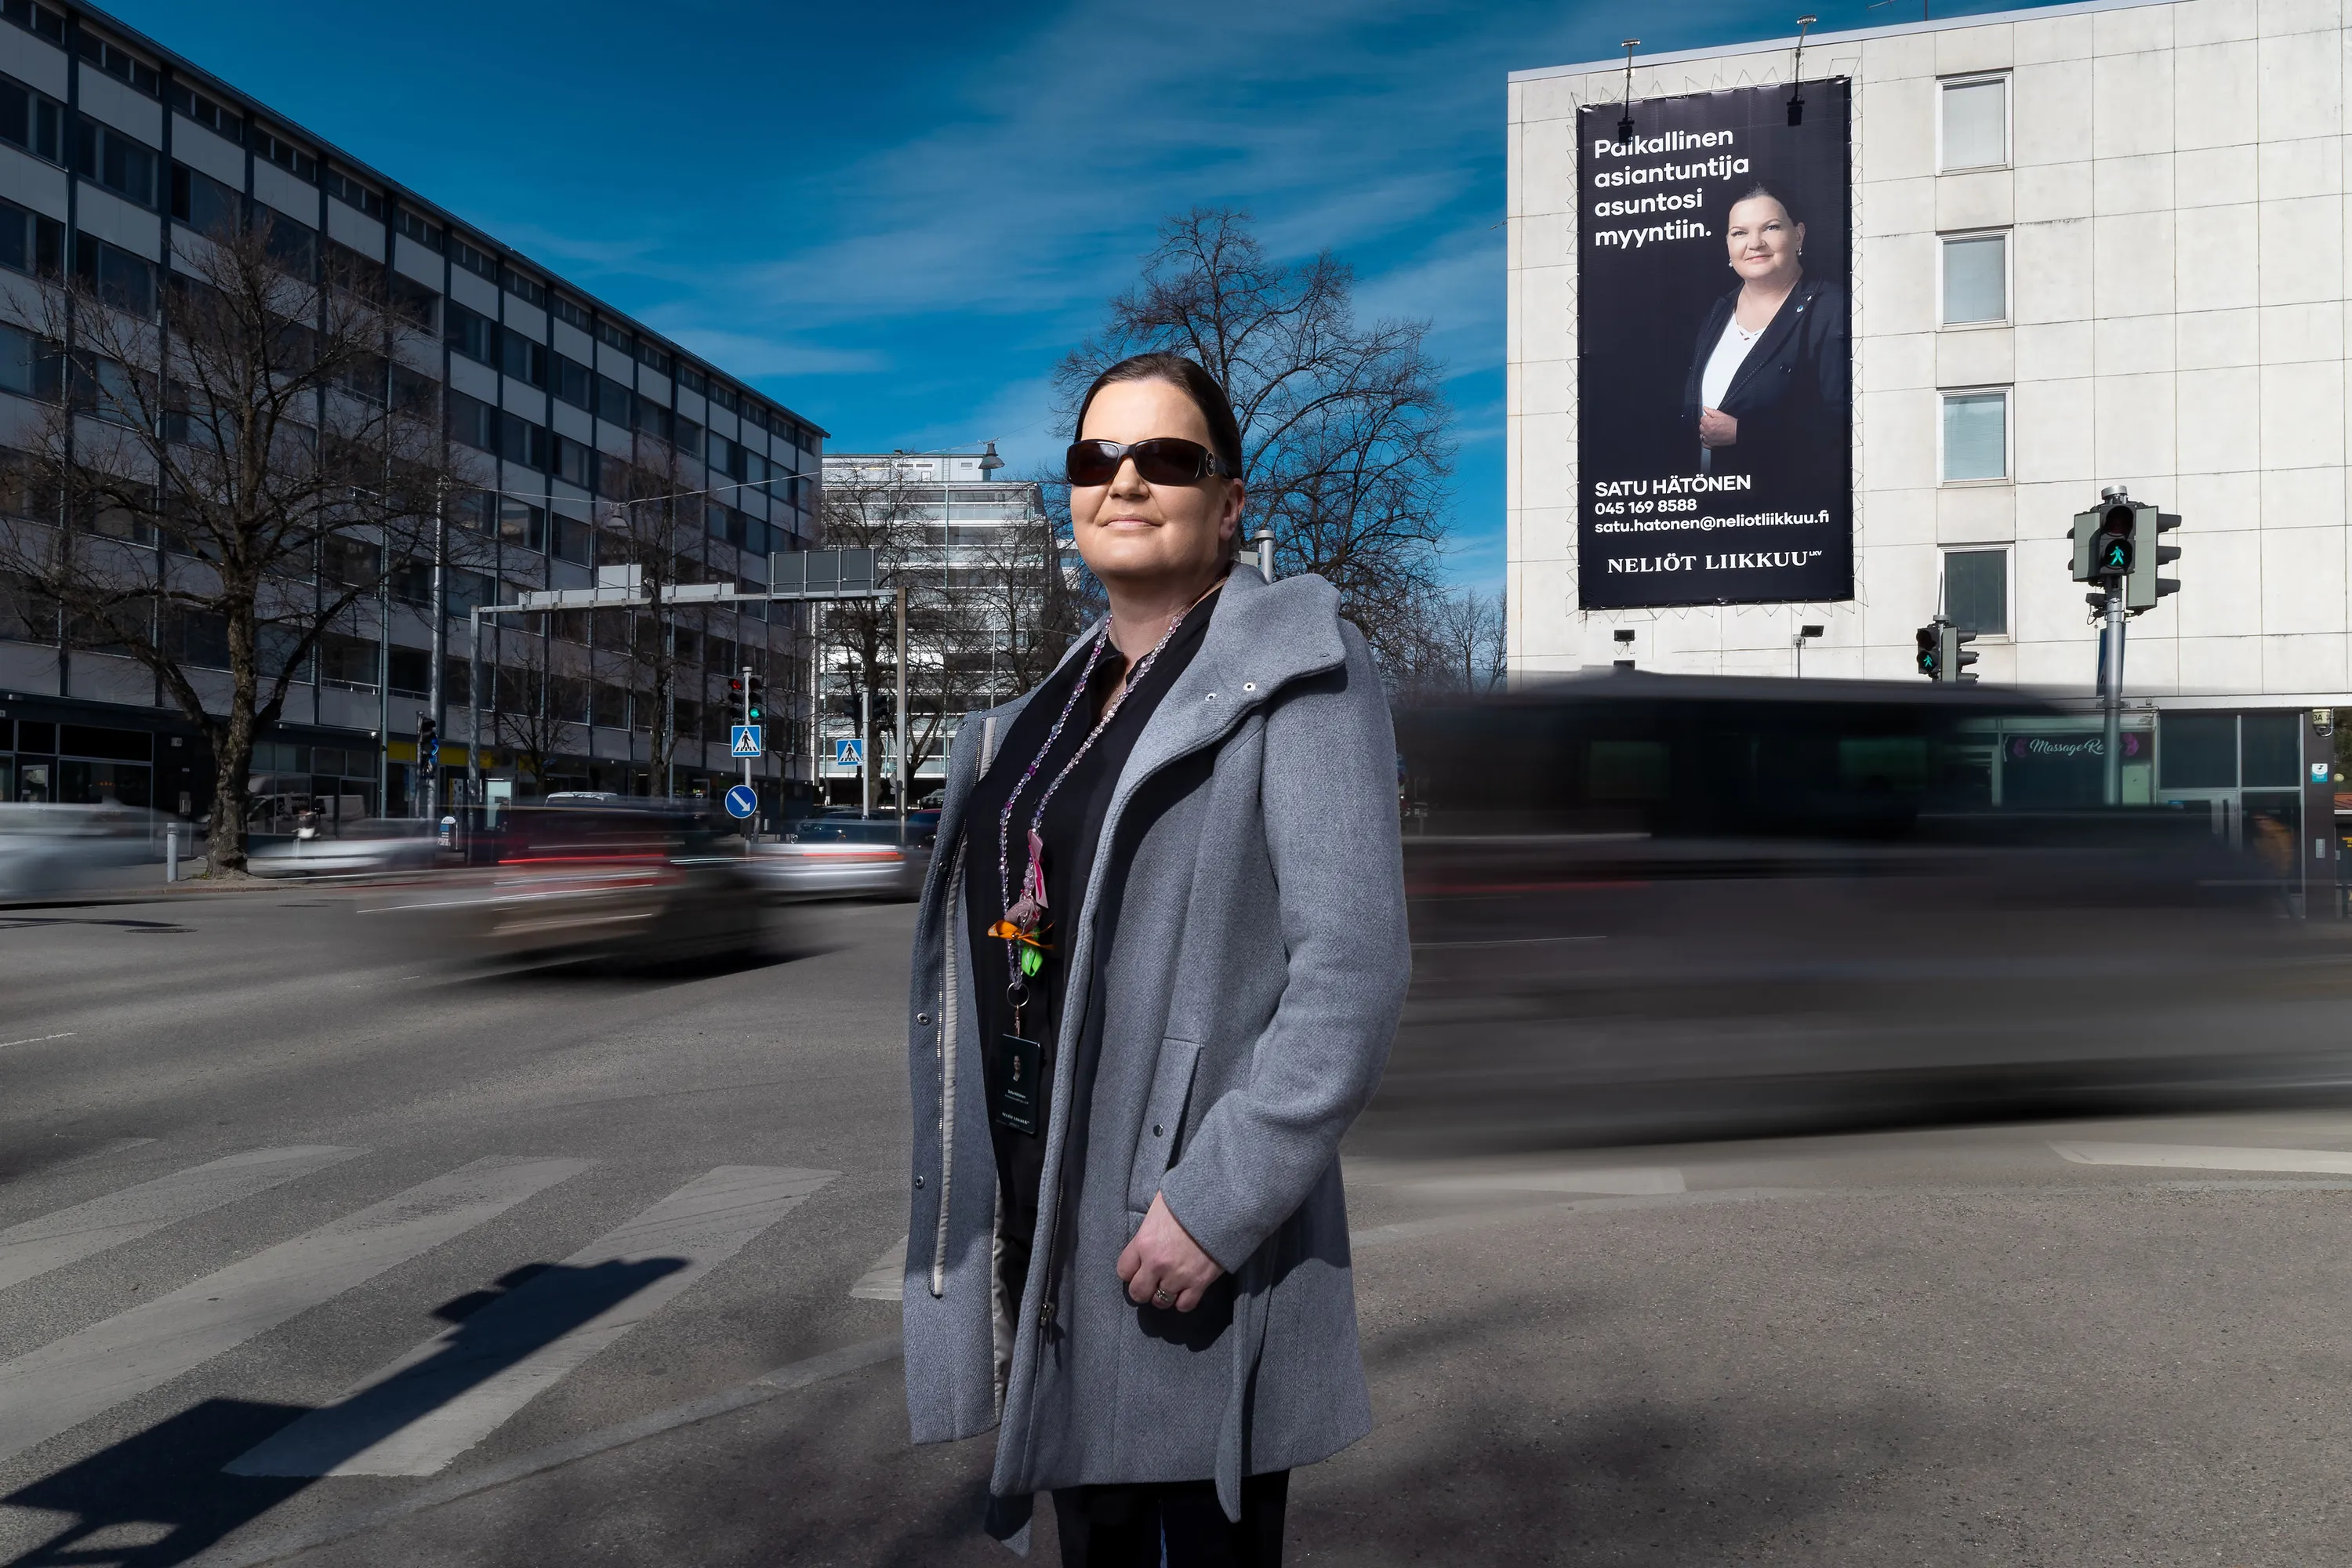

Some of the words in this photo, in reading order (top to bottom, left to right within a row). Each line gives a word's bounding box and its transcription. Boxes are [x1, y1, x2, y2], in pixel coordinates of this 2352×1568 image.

[1595, 129, 1733, 158] Paikallinen
[1594, 154, 1749, 188] asiantuntija
[1594, 187, 1703, 217] asuntosi
[1595, 218, 1712, 249] myyntiin.
[1595, 480, 1647, 497] SATU
[1653, 474, 1751, 495] HÄTÖNEN
[1595, 502, 1625, 515] 045
[1628, 500, 1654, 514] 169
[1657, 498, 1697, 513] 8588
[1595, 510, 1830, 533] satu.hatonen@neliotliikkuu.fi
[1607, 552, 1697, 574] NELIÖT
[1705, 550, 1808, 570] LIIKKUU
[2029, 739, 2083, 757] Massage
